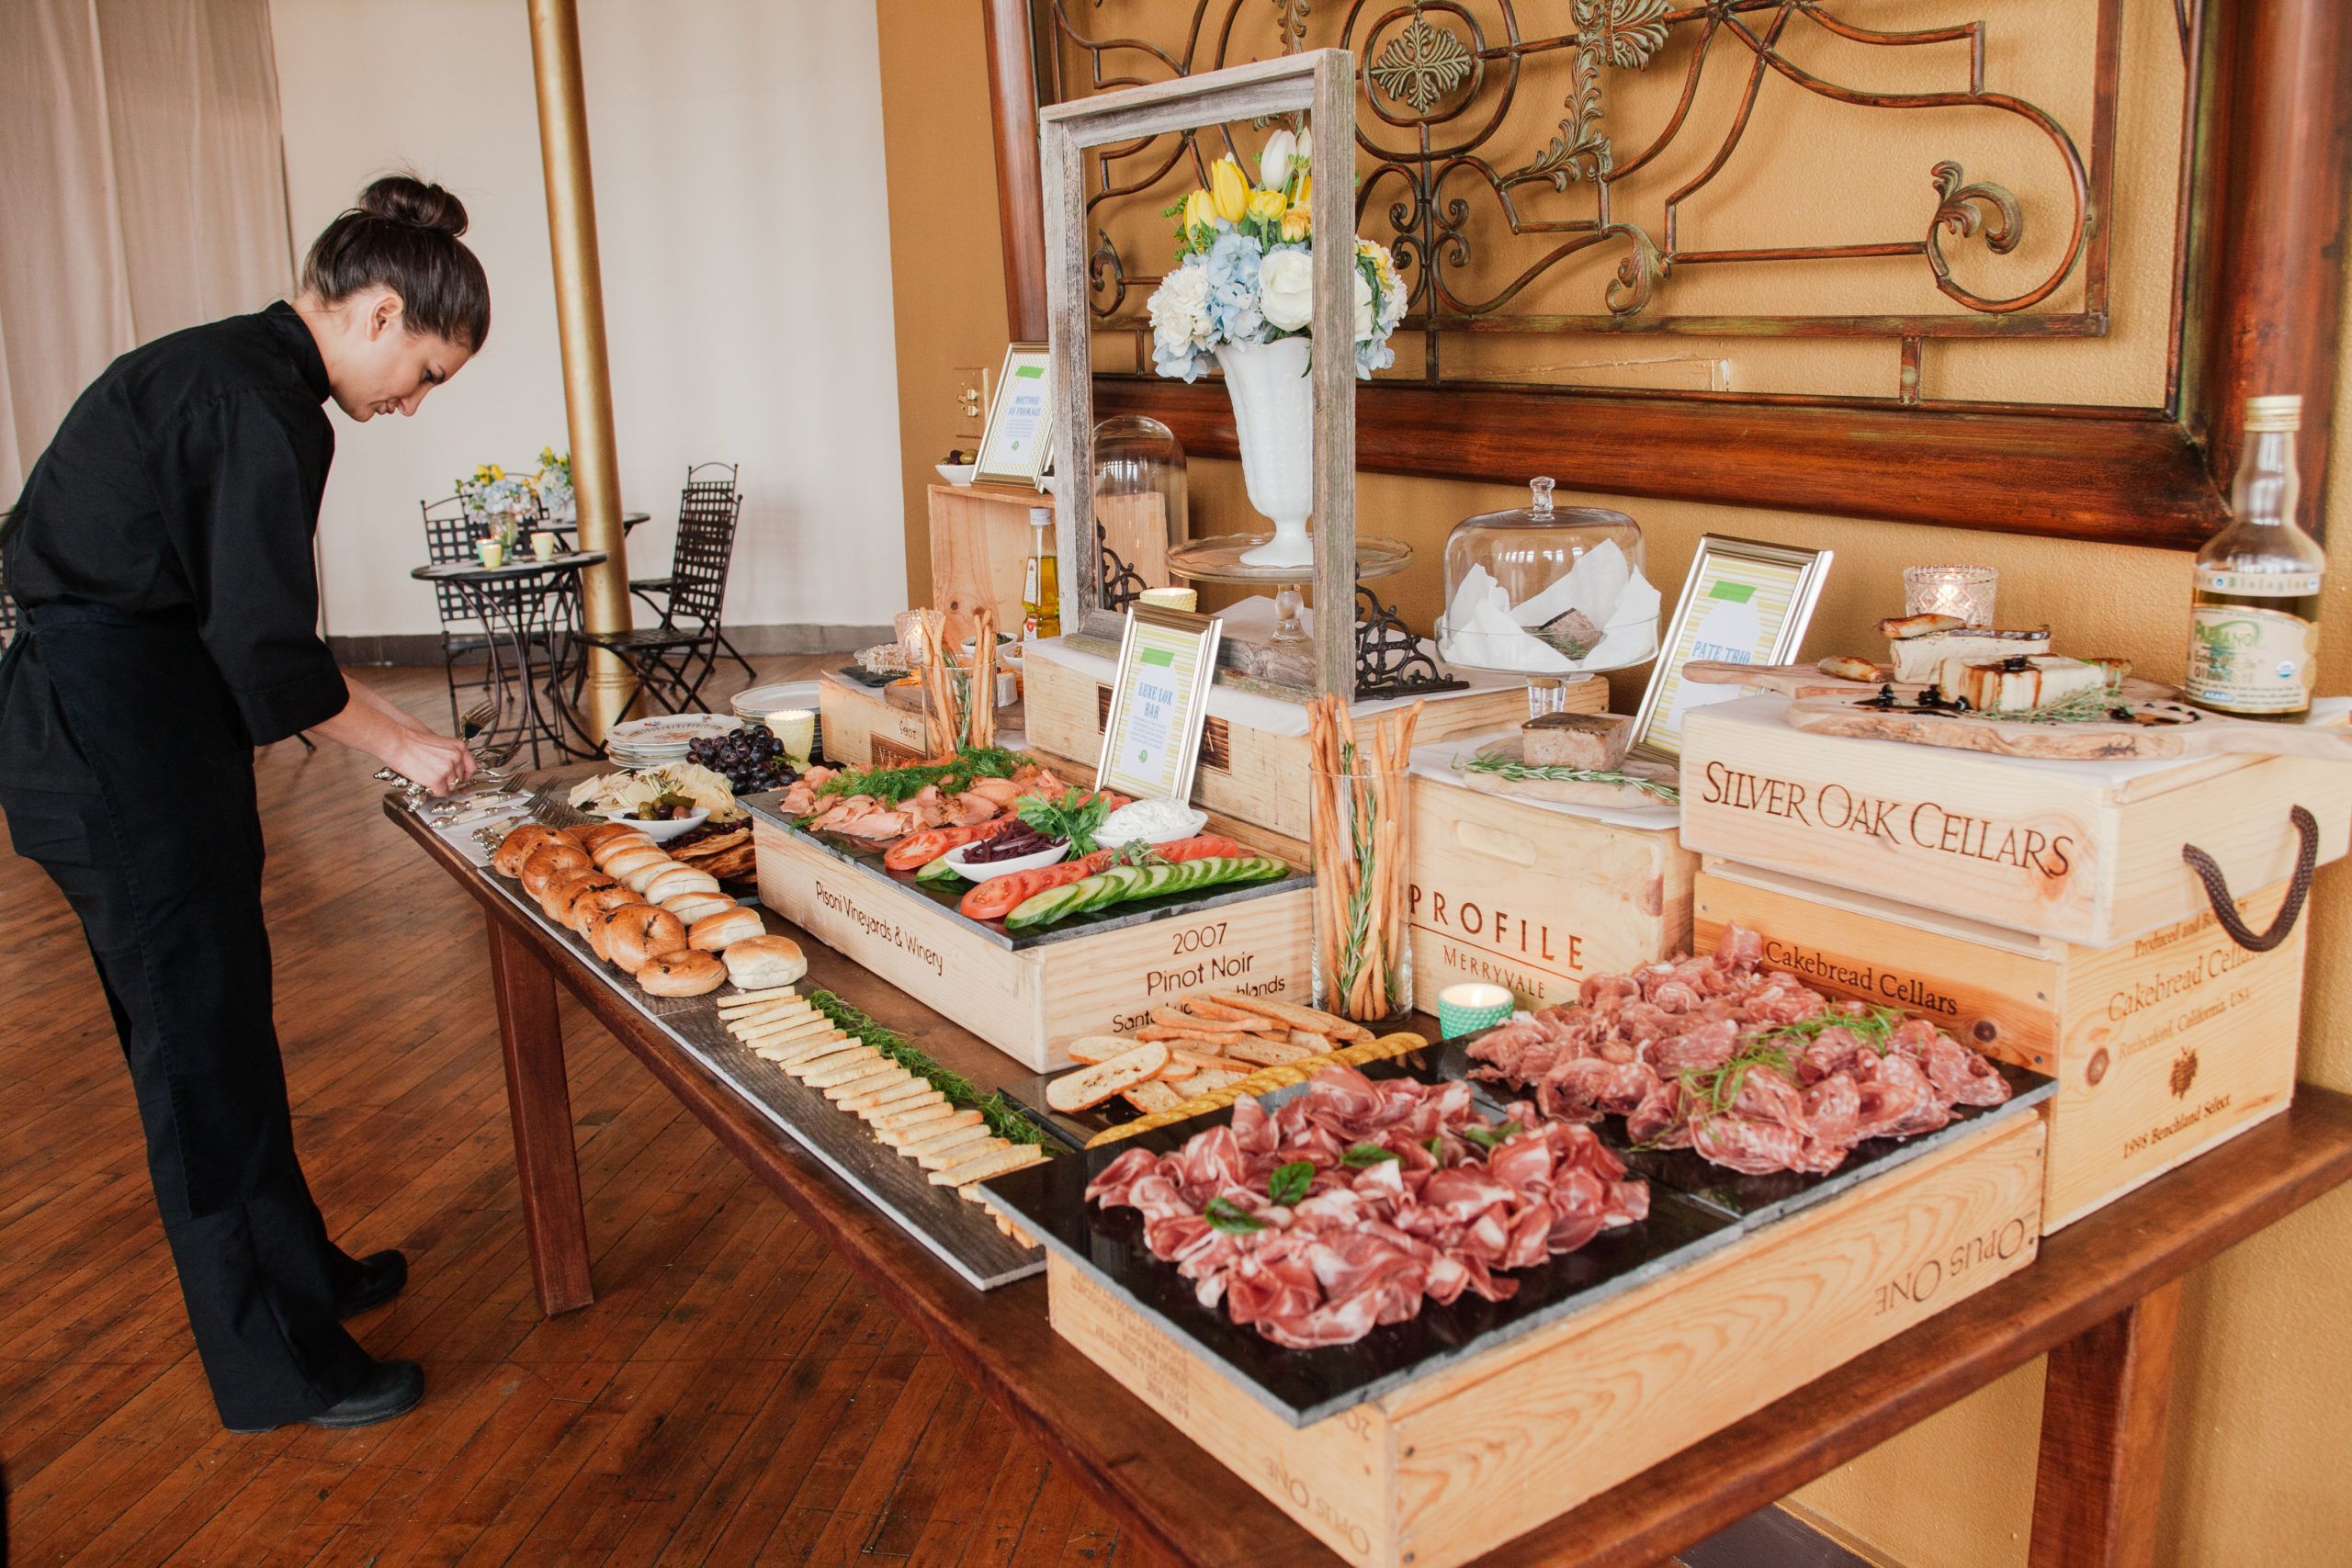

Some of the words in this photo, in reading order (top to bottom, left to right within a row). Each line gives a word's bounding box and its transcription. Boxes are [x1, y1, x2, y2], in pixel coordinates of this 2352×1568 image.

[1691, 641, 1724, 661] PATE
[1138, 682, 1159, 701] LUXE
[1159, 688, 1174, 706] LOX
[1144, 702, 1160, 720] BAR
[1702, 760, 1812, 828] SILVER
[1817, 783, 1902, 845] OAK
[1909, 801, 2075, 880] CELLARS
[816, 880, 842, 914] Pisoni
[843, 895, 892, 942] Vineyards
[894, 926, 903, 948] &
[905, 931, 943, 977] Winery
[1172, 922, 1227, 956] 2007
[1409, 883, 1584, 972] PROFILE
[1147, 962, 1204, 997] Pinot
[1212, 951, 1255, 980] Noir
[1443, 944, 1545, 999] MERRYVALE
[1766, 942, 1873, 992] Cakebread
[1880, 974, 1958, 1016] Cellars
[2108, 954, 2203, 1022] Cakebread
[2208, 940, 2263, 979] Cella
[2203, 1092, 2232, 1118] Select
[1950, 1218, 2025, 1277] OPUS
[1874, 1259, 1941, 1316] ONE
